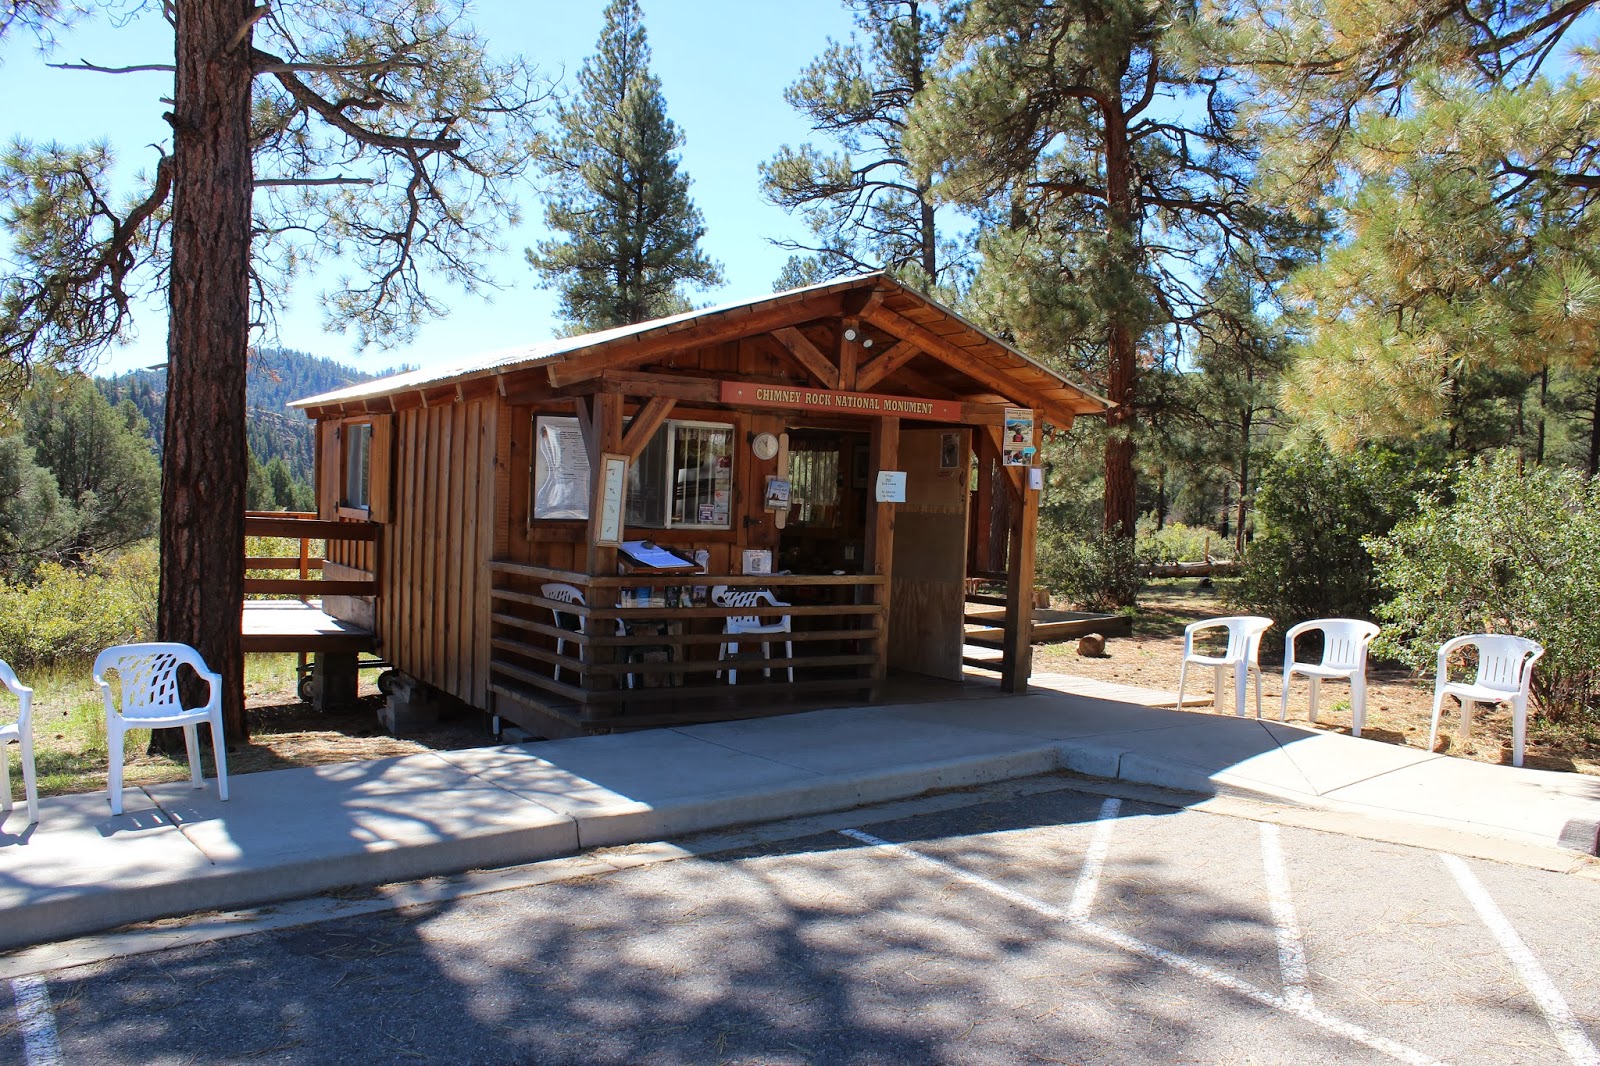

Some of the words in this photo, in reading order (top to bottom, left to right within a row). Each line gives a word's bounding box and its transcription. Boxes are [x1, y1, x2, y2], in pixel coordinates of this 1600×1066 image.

[756, 388, 801, 403] CHIMNEY
[805, 392, 831, 406] ROCK
[835, 395, 880, 410] NATIONAL
[883, 399, 933, 414] MONUMENT
